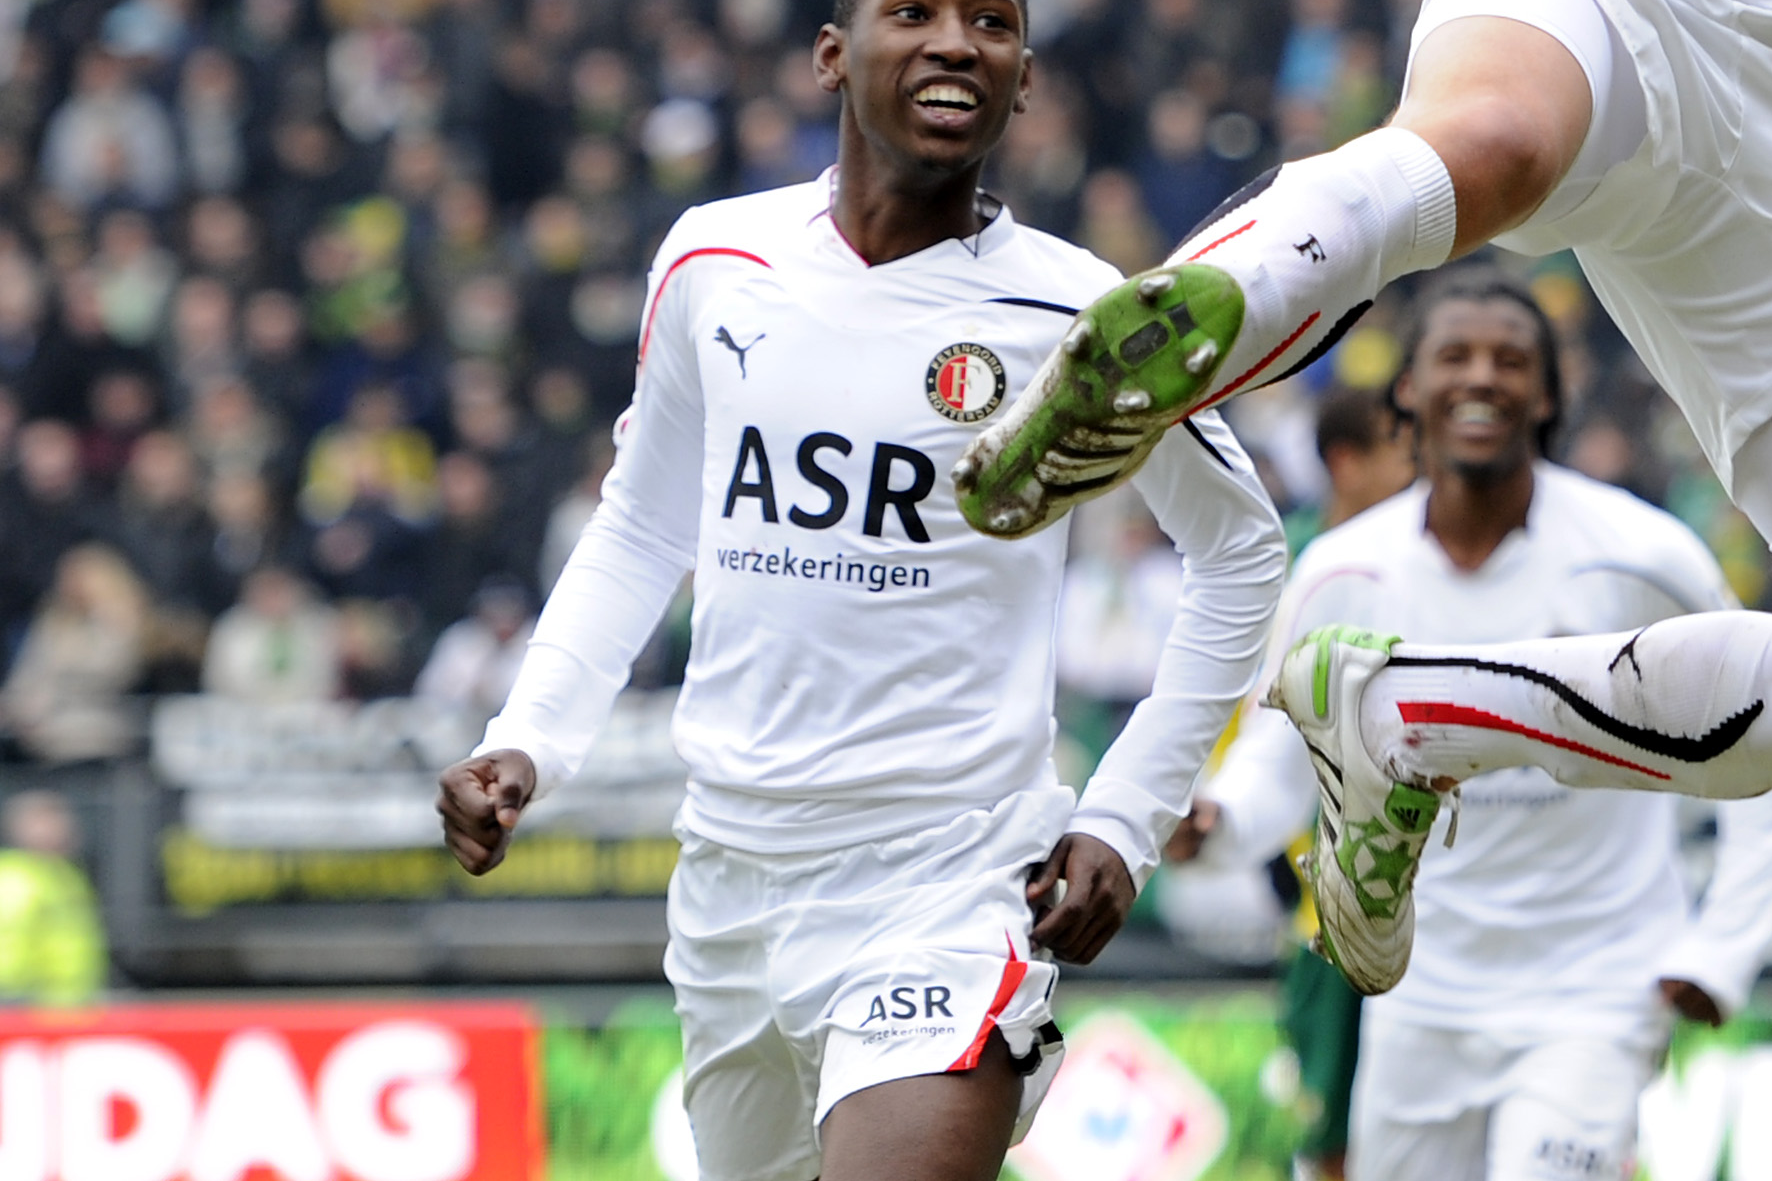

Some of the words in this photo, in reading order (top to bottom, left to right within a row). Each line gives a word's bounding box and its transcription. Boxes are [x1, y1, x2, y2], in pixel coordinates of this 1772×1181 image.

[722, 425, 937, 545] ASR
[715, 546, 932, 593] verzekeringen
[859, 985, 955, 1029] ASR
